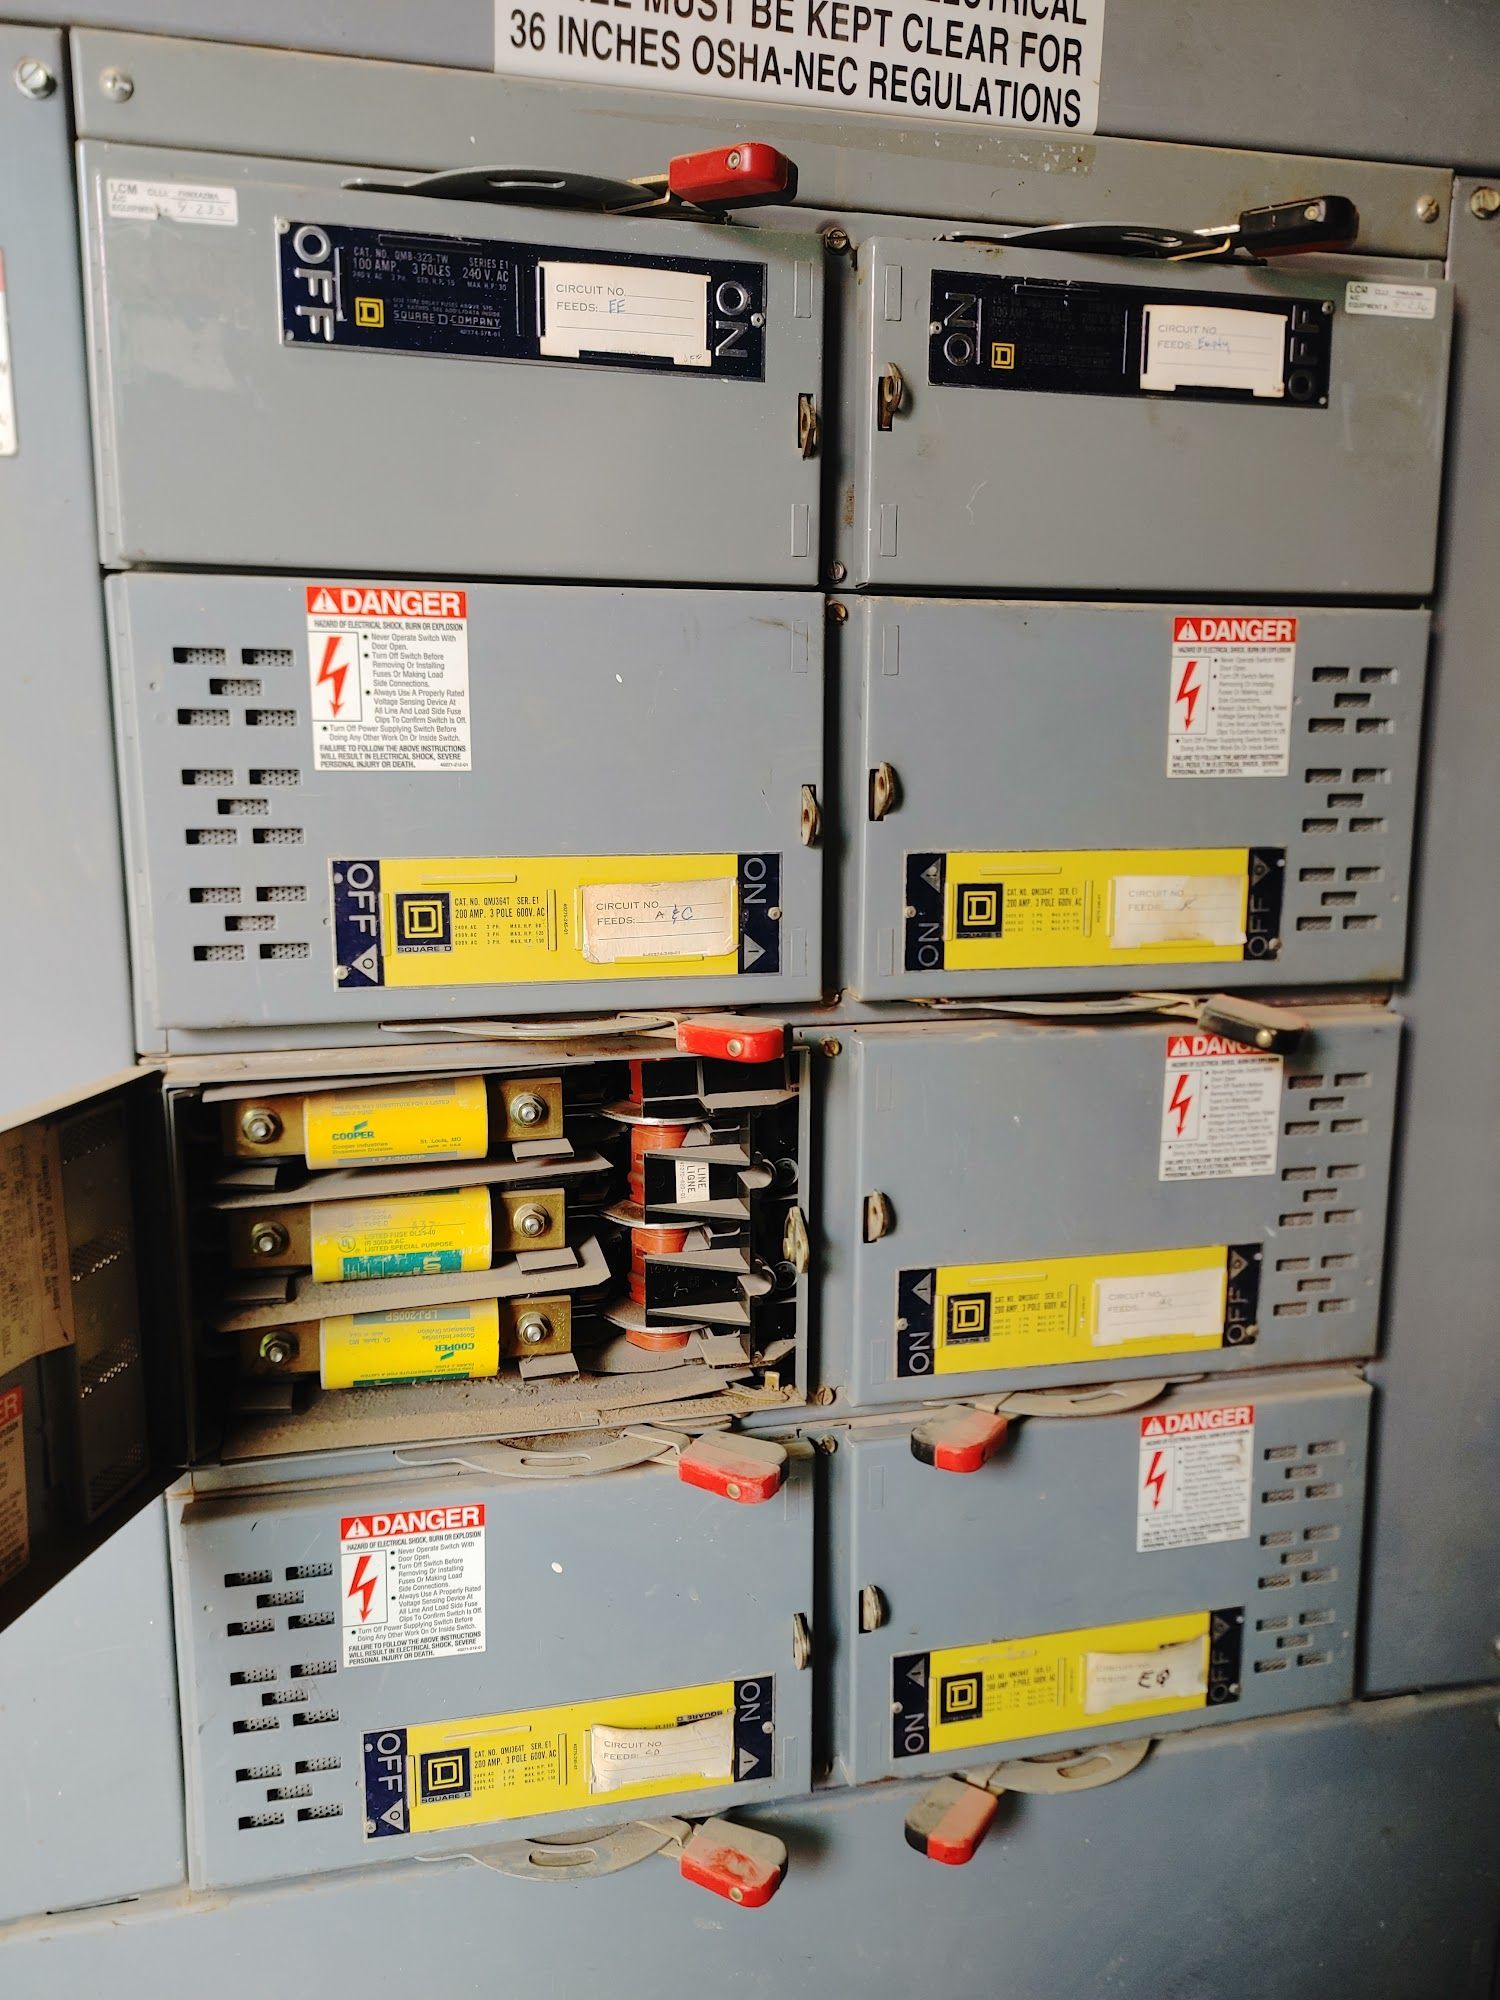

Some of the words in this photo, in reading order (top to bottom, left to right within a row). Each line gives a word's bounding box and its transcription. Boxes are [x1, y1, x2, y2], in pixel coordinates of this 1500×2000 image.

[752, 0, 794, 33] BE
[807, 0, 893, 47] KEPT
[902, 13, 1009, 65] CLEAR
[1019, 31, 1082, 76] FOR
[510, 9, 545, 51] 36
[558, 14, 680, 71] INCHES
[692, 35, 857, 96] OSHA-NEC
[869, 60, 1081, 127] REGULATIONS
[293, 225, 335, 341] OFF
[555, 284, 603, 298] CIRCUIT
[556, 301, 598, 314] FEEDS:
[716, 280, 750, 357] ON
[341, 589, 461, 617] DANGER
[314, 620, 338, 628] HAZARD
[348, 621, 381, 629] ELECTRICAL
[382, 622, 404, 630] SHOCK,
[432, 623, 463, 631] EXPLOSION
[1200, 619, 1292, 642] DANGER
[743, 857, 768, 905] ON
[347, 862, 377, 937] OFF
[596, 900, 640, 911] CIRCUIT
[455, 909, 468, 919] 200
[469, 909, 486, 919] AMP.
[489, 908, 495, 918] 3
[496, 908, 513, 918] POLE
[516, 907, 535, 917] 600V.
[536, 907, 546, 917] AC
[597, 916, 637, 927] FEEDS:
[397, 946, 440, 954] SQUARE
[918, 922, 940, 967] ON
[331, 1131, 375, 1141] COOPER
[686, 1165, 696, 1193] LIGNE
[697, 1167, 707, 1189] LINE
[384, 1309, 439, 1322] LPJ-200SP
[434, 1342, 475, 1352] COOPER
[908, 1332, 930, 1374] ON
[1166, 1408, 1249, 1432] DANGER
[372, 1507, 480, 1537] DANGER
[347, 1543, 368, 1551] HAZARD
[377, 1539, 408, 1548] ELECTRICAL
[408, 1537, 428, 1545] SHOCK,
[429, 1535, 443, 1543] BURN
[452, 1531, 481, 1540] EXPLOSION
[398, 1548, 415, 1556] Never
[416, 1545, 439, 1554] Operate
[414, 1554, 430, 1562] Open.
[444, 1558, 464, 1566] Before
[398, 1569, 428, 1578] Removing
[437, 1565, 464, 1574] Installing
[348, 1644, 373, 1652] FAILURE
[382, 1641, 407, 1649] FOLLOW
[420, 1636, 439, 1644] ABOVE
[440, 1631, 482, 1642] INSTRUCTIONS
[364, 1649, 388, 1657] RESULT
[396, 1645, 430, 1654] ELECTRICAL
[431, 1642, 454, 1651] SHOCK,
[454, 1638, 476, 1647] SEVERE
[348, 1657, 381, 1666] PERSONAL
[381, 1653, 403, 1662] INJURY
[413, 1650, 435, 1659] DEATH.
[739, 1682, 761, 1722] ON
[904, 1712, 925, 1753] ON
[603, 1741, 644, 1749] CIRCUIT
[377, 1732, 403, 1793] OFF
[474, 1760, 486, 1769] 200
[487, 1757, 502, 1767] AMP.
[506, 1756, 510, 1765] 3
[511, 1753, 527, 1764] POLE
[530, 1751, 548, 1761] 600V.
[548, 1749, 557, 1759] AC
[421, 1794, 460, 1804] SQUARE
